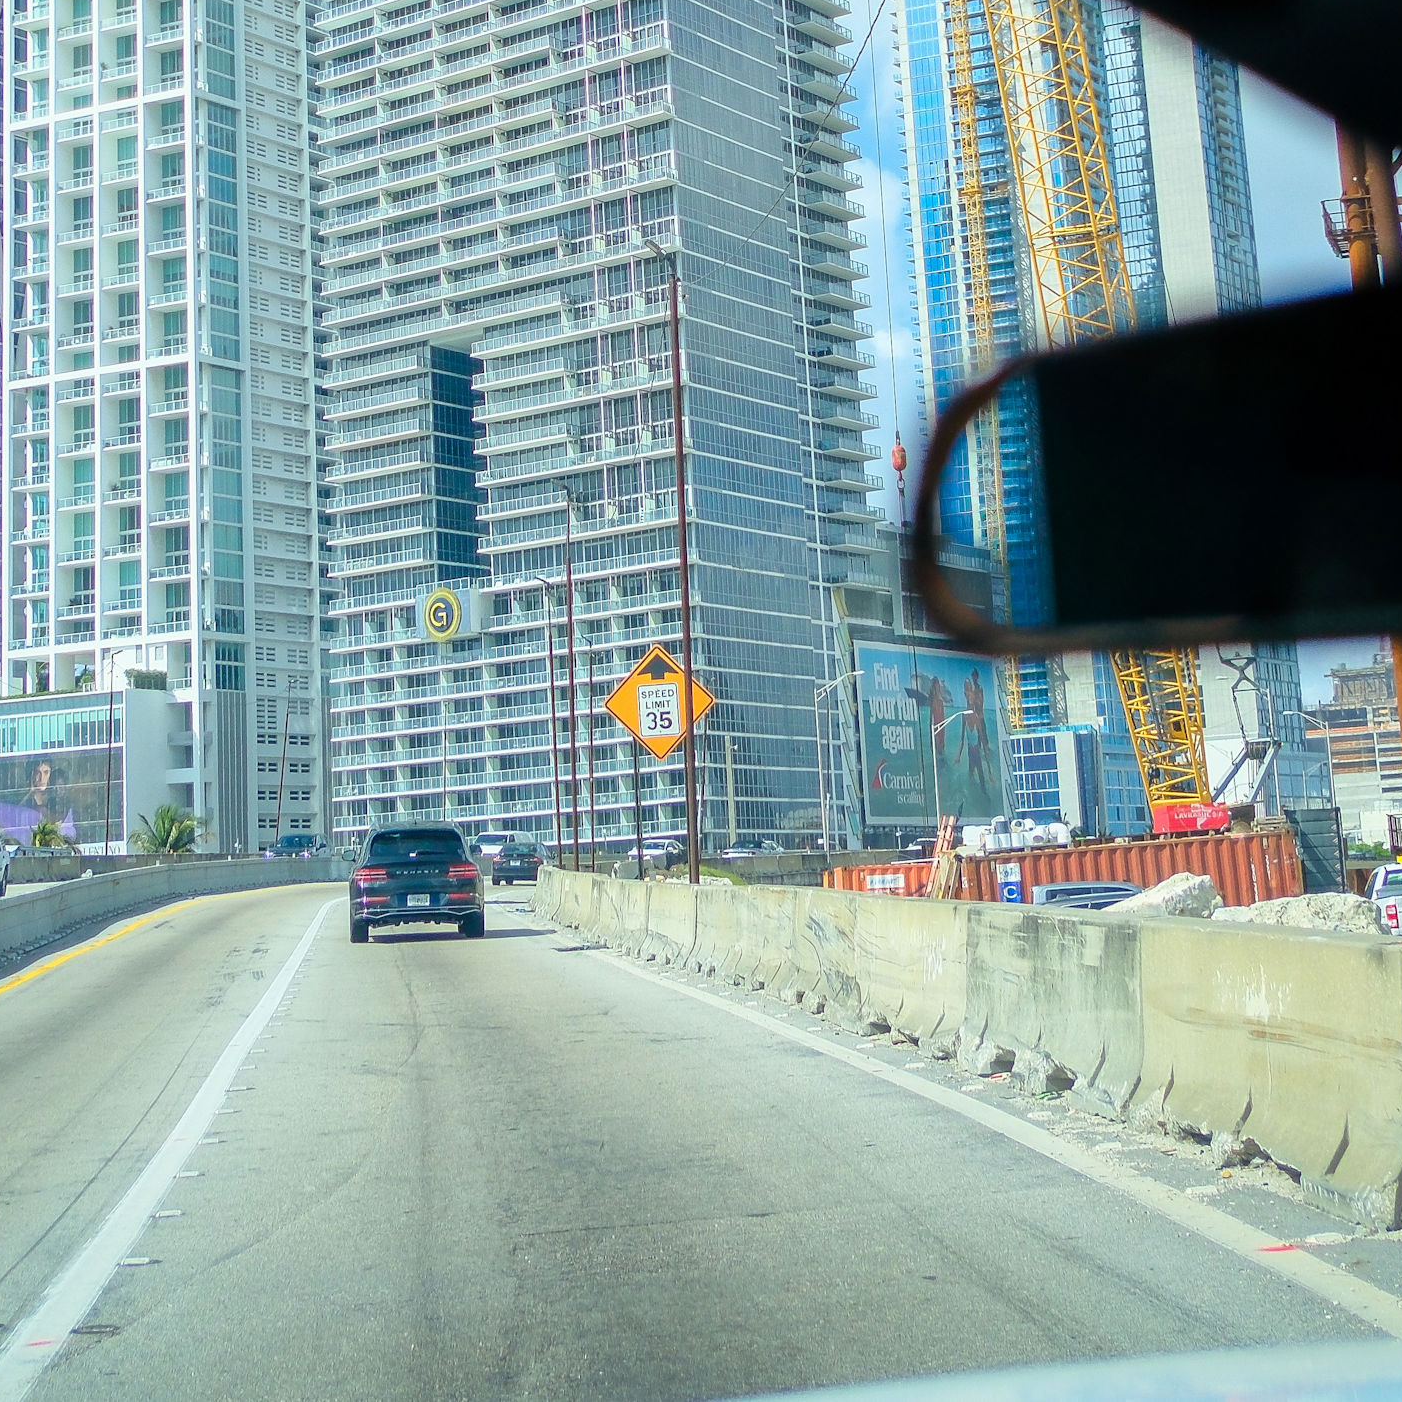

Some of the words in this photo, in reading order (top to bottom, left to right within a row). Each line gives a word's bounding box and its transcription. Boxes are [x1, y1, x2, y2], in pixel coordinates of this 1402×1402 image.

[430, 602, 447, 627] G
[873, 662, 900, 691] Find
[641, 689, 675, 699] SPEED
[645, 700, 671, 710] LIMIT
[869, 696, 896, 723] your
[897, 694, 918, 722] fun
[646, 711, 673, 730] 35
[882, 723, 915, 755] again
[883, 772, 924, 790] Carnival
